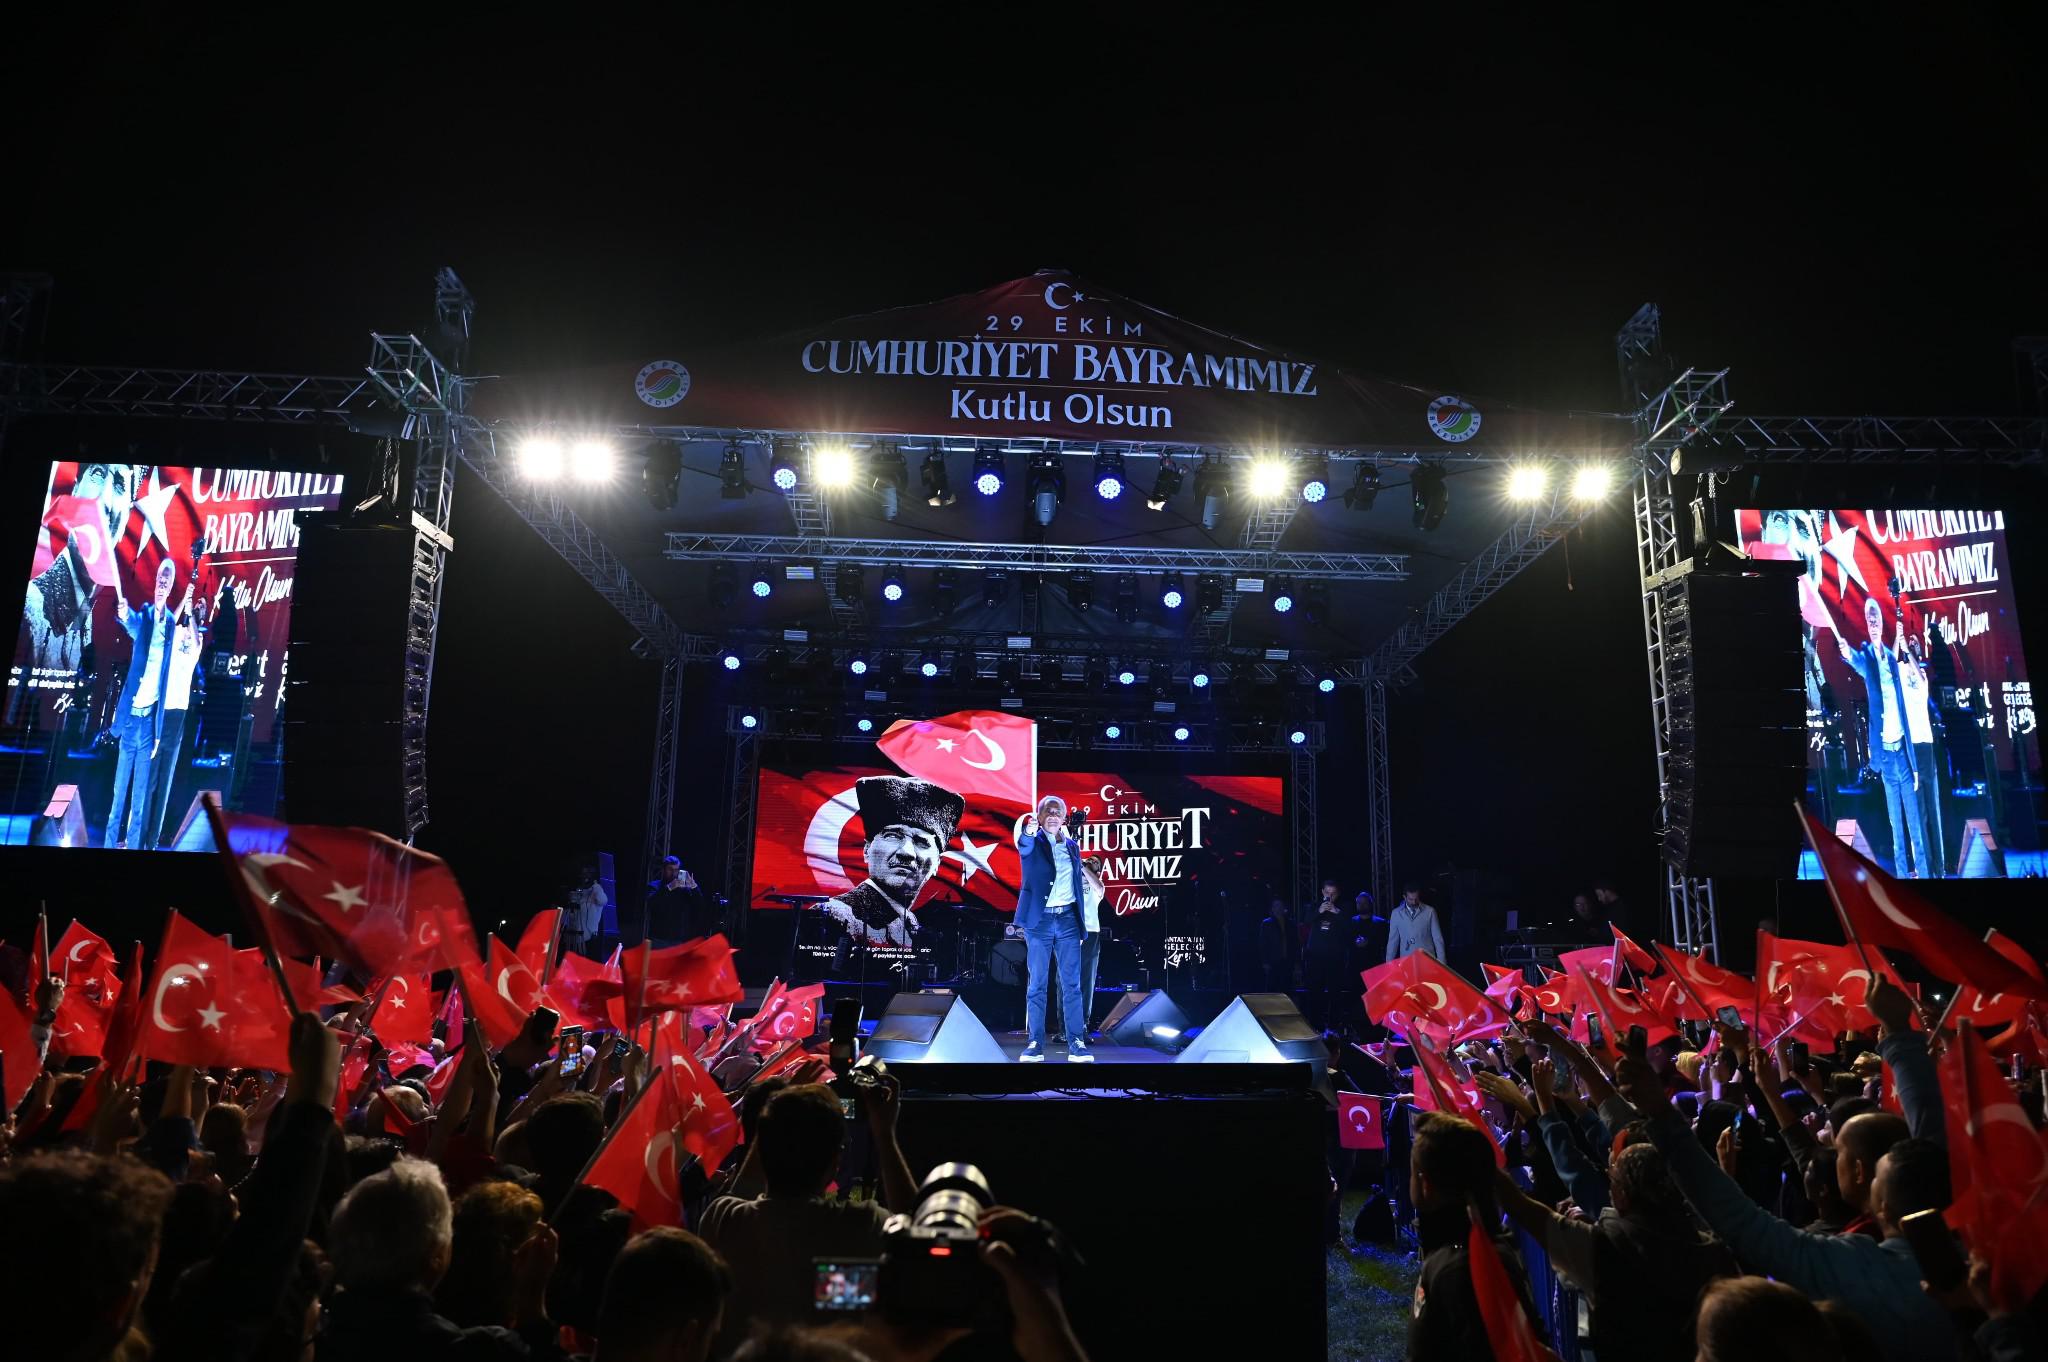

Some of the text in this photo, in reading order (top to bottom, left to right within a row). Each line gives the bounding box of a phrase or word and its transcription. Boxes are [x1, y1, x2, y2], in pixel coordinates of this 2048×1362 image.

[986, 315, 1142, 337] 29 EKİM
[801, 335, 1318, 397] CUMHURİYET BAYRAMIMIZ
[950, 388, 1173, 430] Kutlu Olsun
[202, 507, 314, 554] BAYRAMIM
[1892, 542, 1999, 593] BAYRAMIMIZ
[1013, 808, 1211, 851] CMHURİYET
[1107, 803, 1156, 815] EKİM
[1098, 854, 1184, 881] AMIMIZ
[1115, 888, 1160, 917] Olsun
